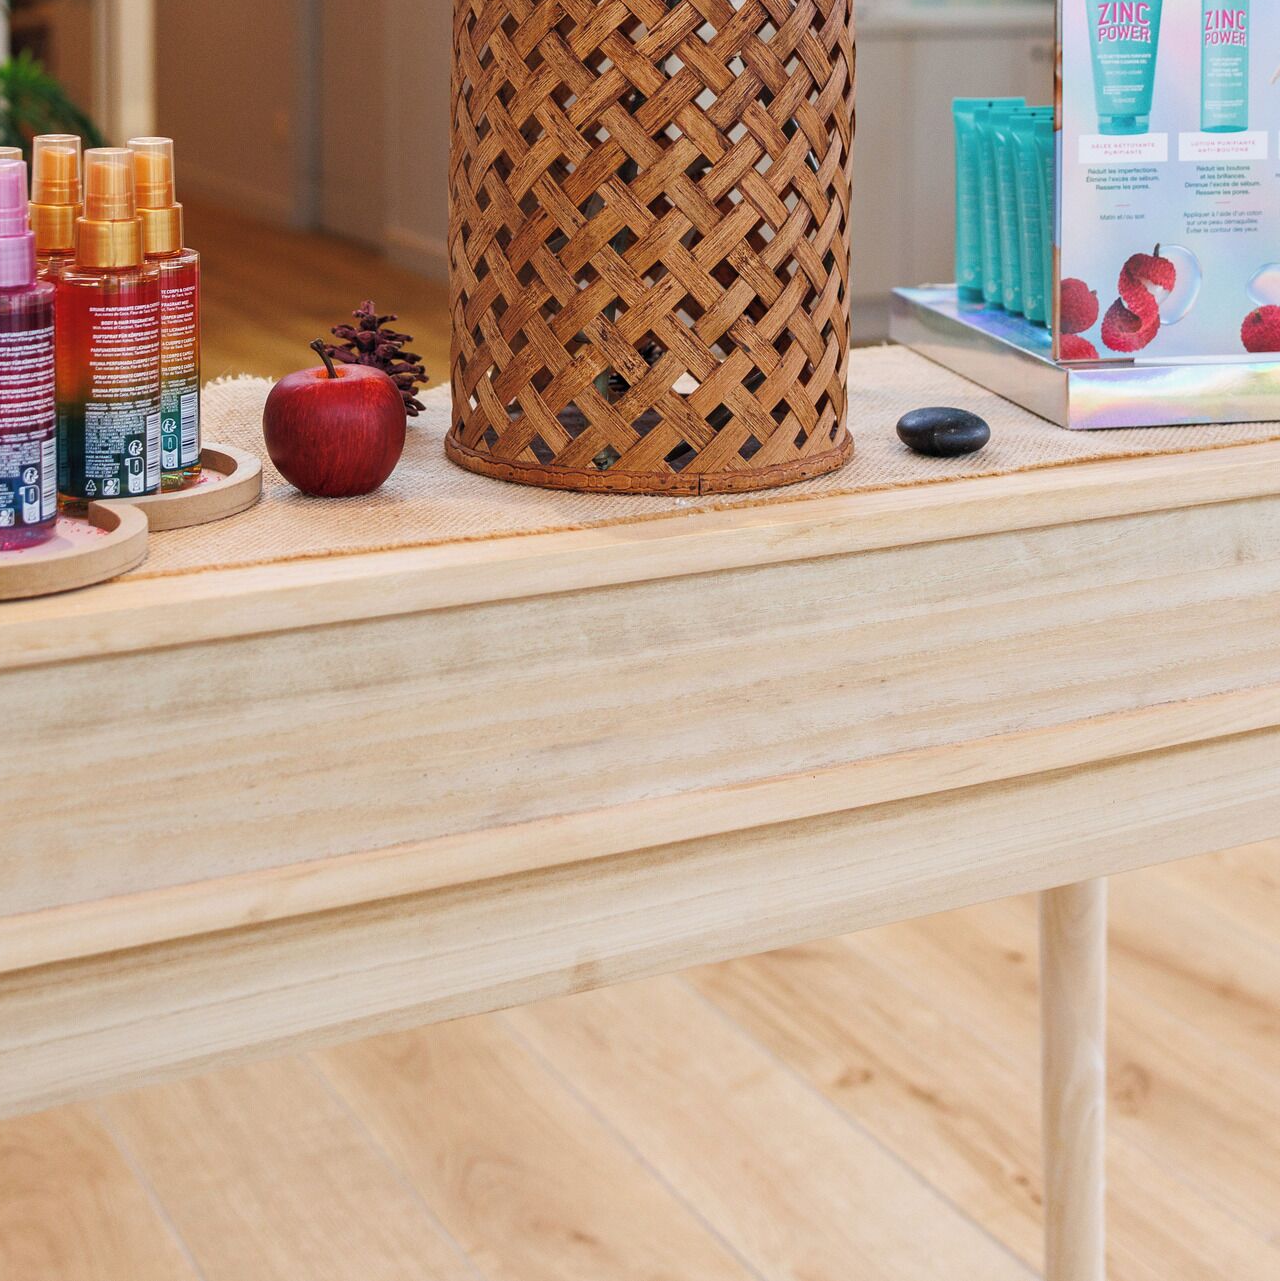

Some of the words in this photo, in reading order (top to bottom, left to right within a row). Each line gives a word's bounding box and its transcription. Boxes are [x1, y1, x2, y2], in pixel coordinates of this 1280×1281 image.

[1097, 0, 1151, 26] ZINC
[1204, 10, 1247, 32] ZINC
[1098, 25, 1151, 44] POWER
[1204, 31, 1247, 48] POWER
